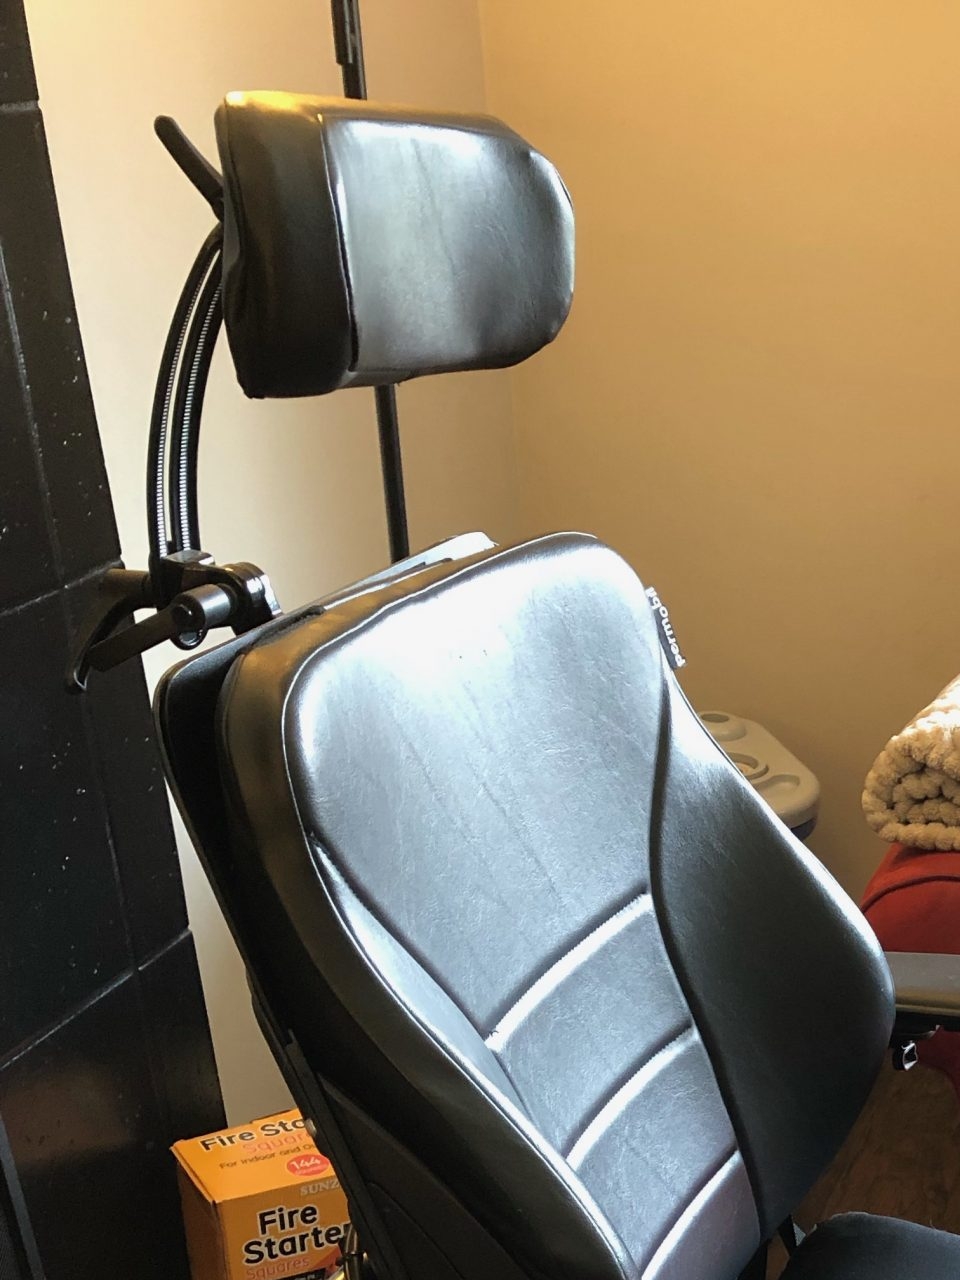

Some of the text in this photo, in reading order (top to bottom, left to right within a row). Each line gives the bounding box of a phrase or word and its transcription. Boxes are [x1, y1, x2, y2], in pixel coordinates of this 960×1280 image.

[645, 586, 686, 668] permobil
[200, 1129, 255, 1152] Fire
[242, 1132, 311, 1155] Squar
[219, 1159, 238, 1170] For
[241, 1150, 275, 1166] indoor
[279, 1145, 302, 1157] and
[289, 1156, 321, 1169] 144
[259, 1205, 318, 1235] Fire
[246, 1258, 309, 1280] Squares
